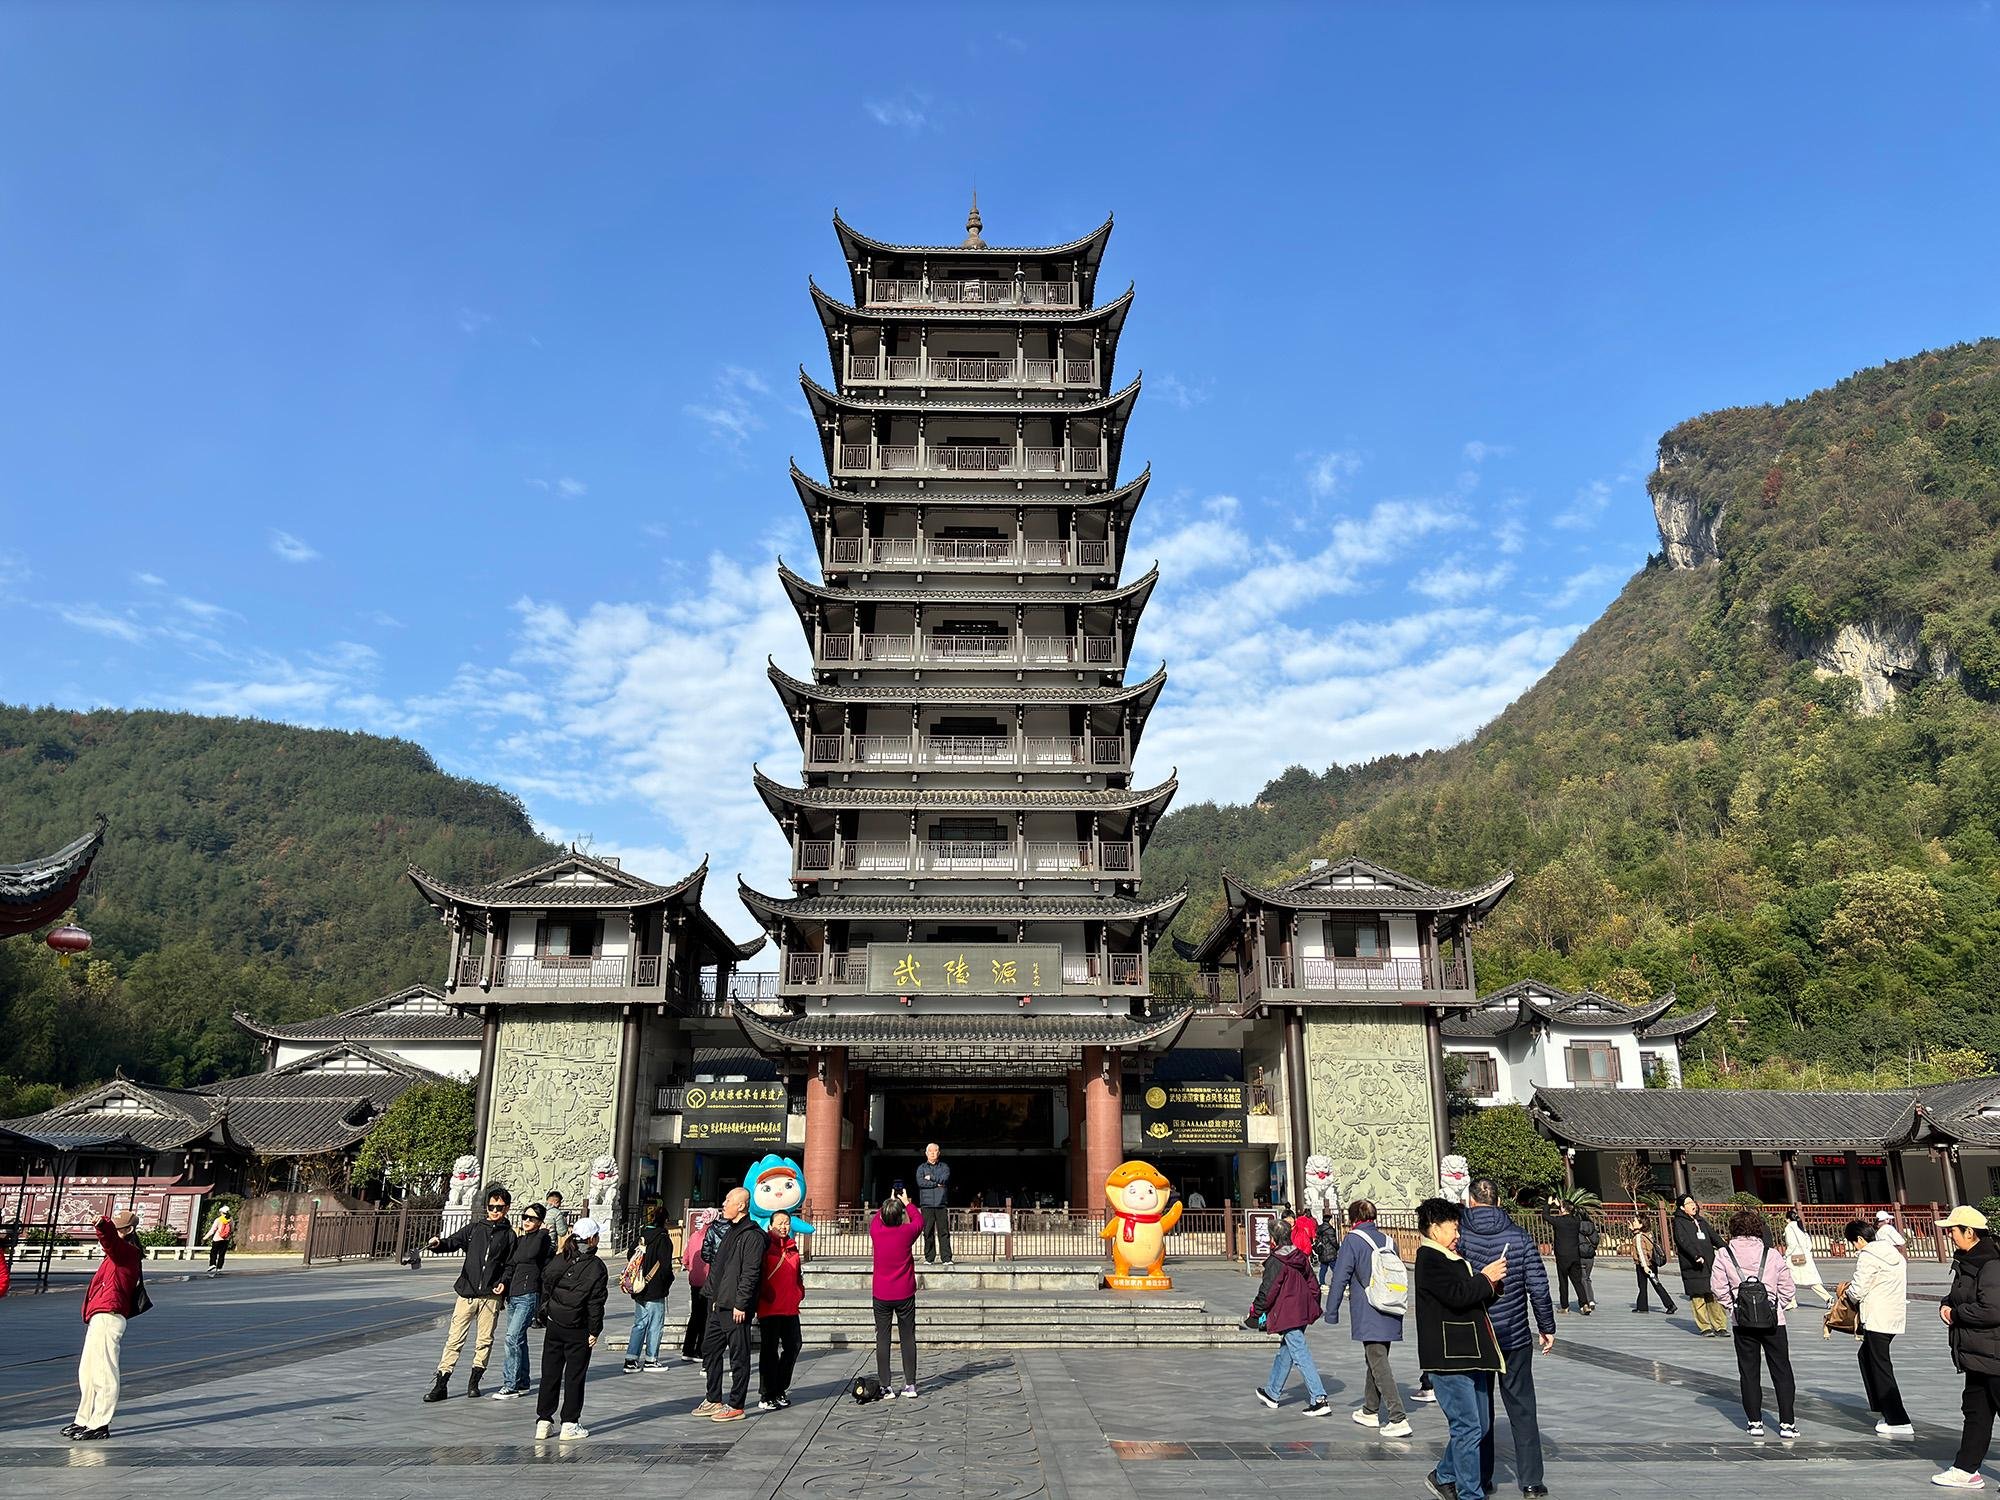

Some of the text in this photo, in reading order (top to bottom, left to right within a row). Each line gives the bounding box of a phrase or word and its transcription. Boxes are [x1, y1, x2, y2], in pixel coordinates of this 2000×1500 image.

[892, 953, 1017, 987] 武陵源
[709, 1088, 784, 1101] 武陵源世界自然遗产
[1169, 1093, 1242, 1103] 武陵源国家重点风景名胜区
[1172, 1119, 1242, 1128] 国家AAAAA级旅游景区
